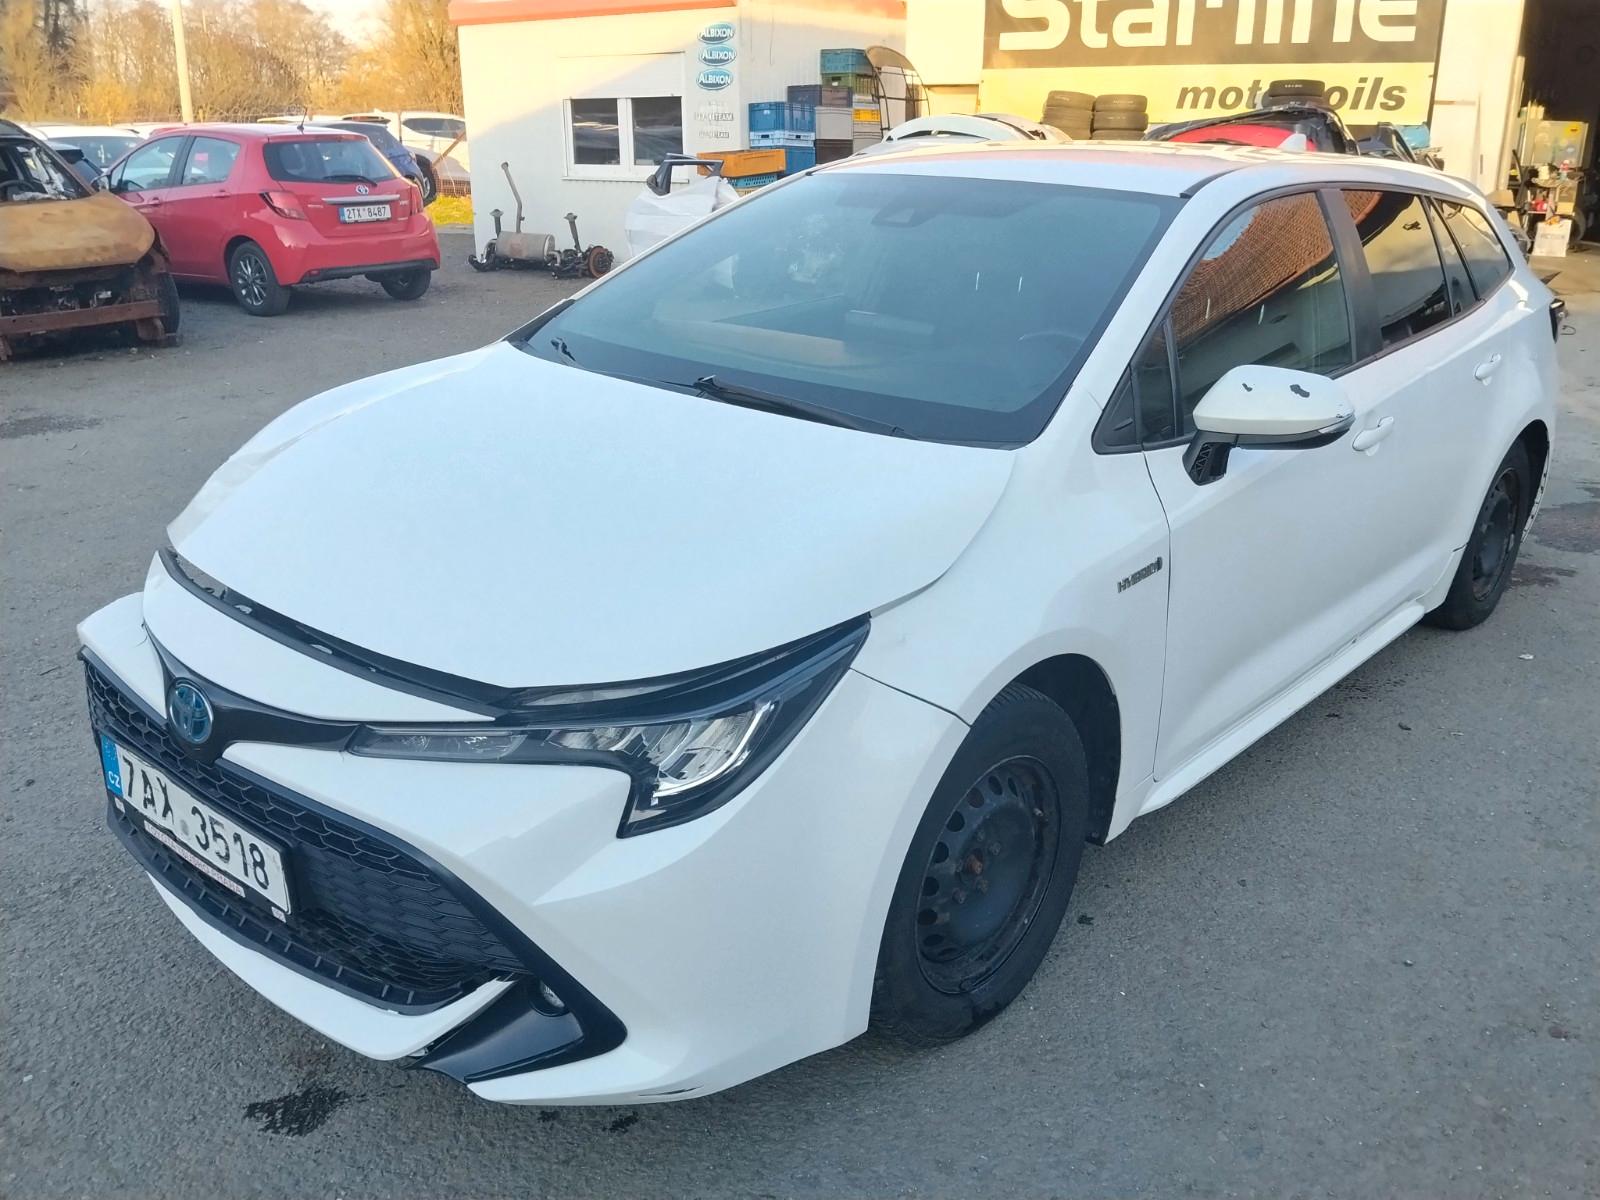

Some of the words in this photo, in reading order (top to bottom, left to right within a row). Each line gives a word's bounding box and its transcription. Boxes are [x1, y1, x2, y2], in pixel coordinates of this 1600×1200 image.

[701, 28, 734, 38] ALBIXON
[702, 49, 736, 61] ALBIXON
[699, 73, 731, 86] ALBIXON
[1324, 77, 1407, 112] oils
[346, 207, 362, 219] 2TX
[367, 206, 387, 218] 8487
[108, 768, 121, 789] CZ
[122, 755, 175, 824] 7AX
[191, 806, 270, 890] 3518
